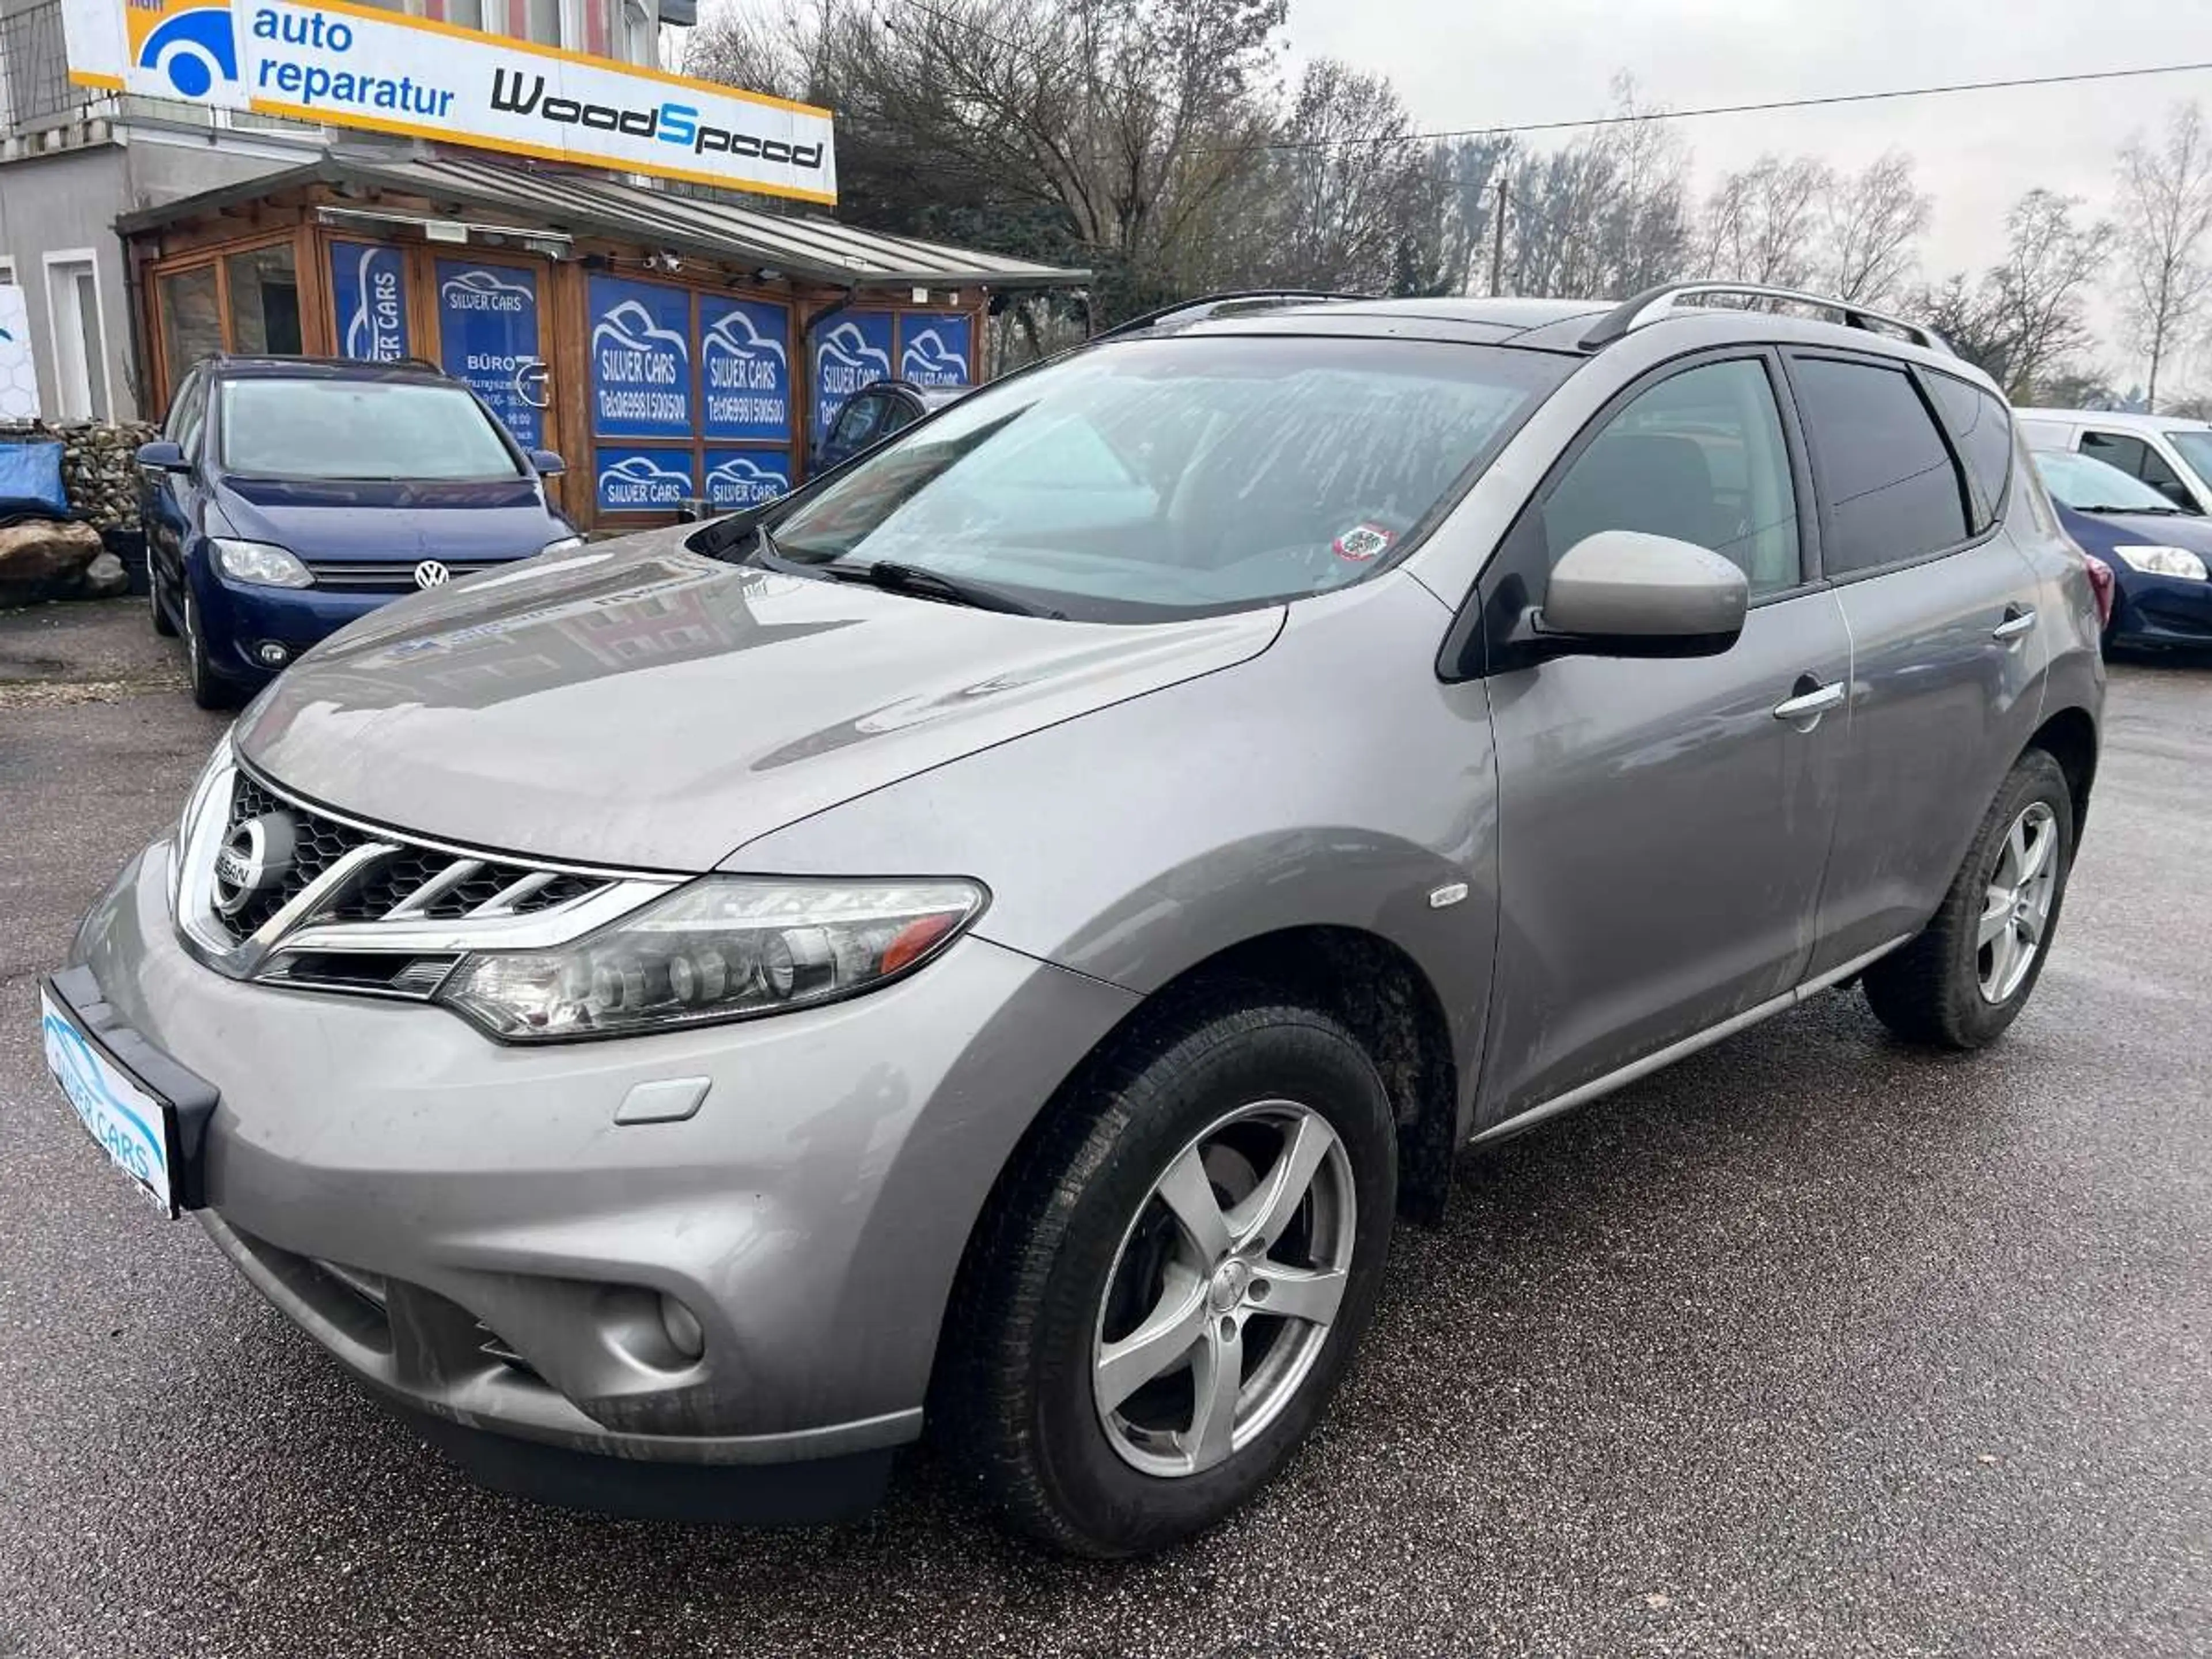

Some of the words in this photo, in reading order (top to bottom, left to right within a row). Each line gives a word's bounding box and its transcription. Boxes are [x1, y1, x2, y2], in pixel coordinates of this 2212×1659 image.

[253, 8, 353, 52] auto
[259, 58, 455, 117] reparatur
[374, 272, 398, 329] CARS
[450, 293, 490, 310] SILVER
[491, 295, 522, 311] CARS
[467, 353, 516, 372] BÜRO
[602, 349, 643, 382] SILVER
[645, 351, 676, 385] CARS
[710, 357, 748, 388] SILVER
[748, 359, 776, 390] CARS
[824, 365, 855, 394] SILVER
[608, 484, 647, 502] SILVER
[649, 484, 680, 502] CARS
[713, 484, 749, 502] SILVER
[750, 485, 778, 502] CARS
[97, 1109, 150, 1179] CARS
